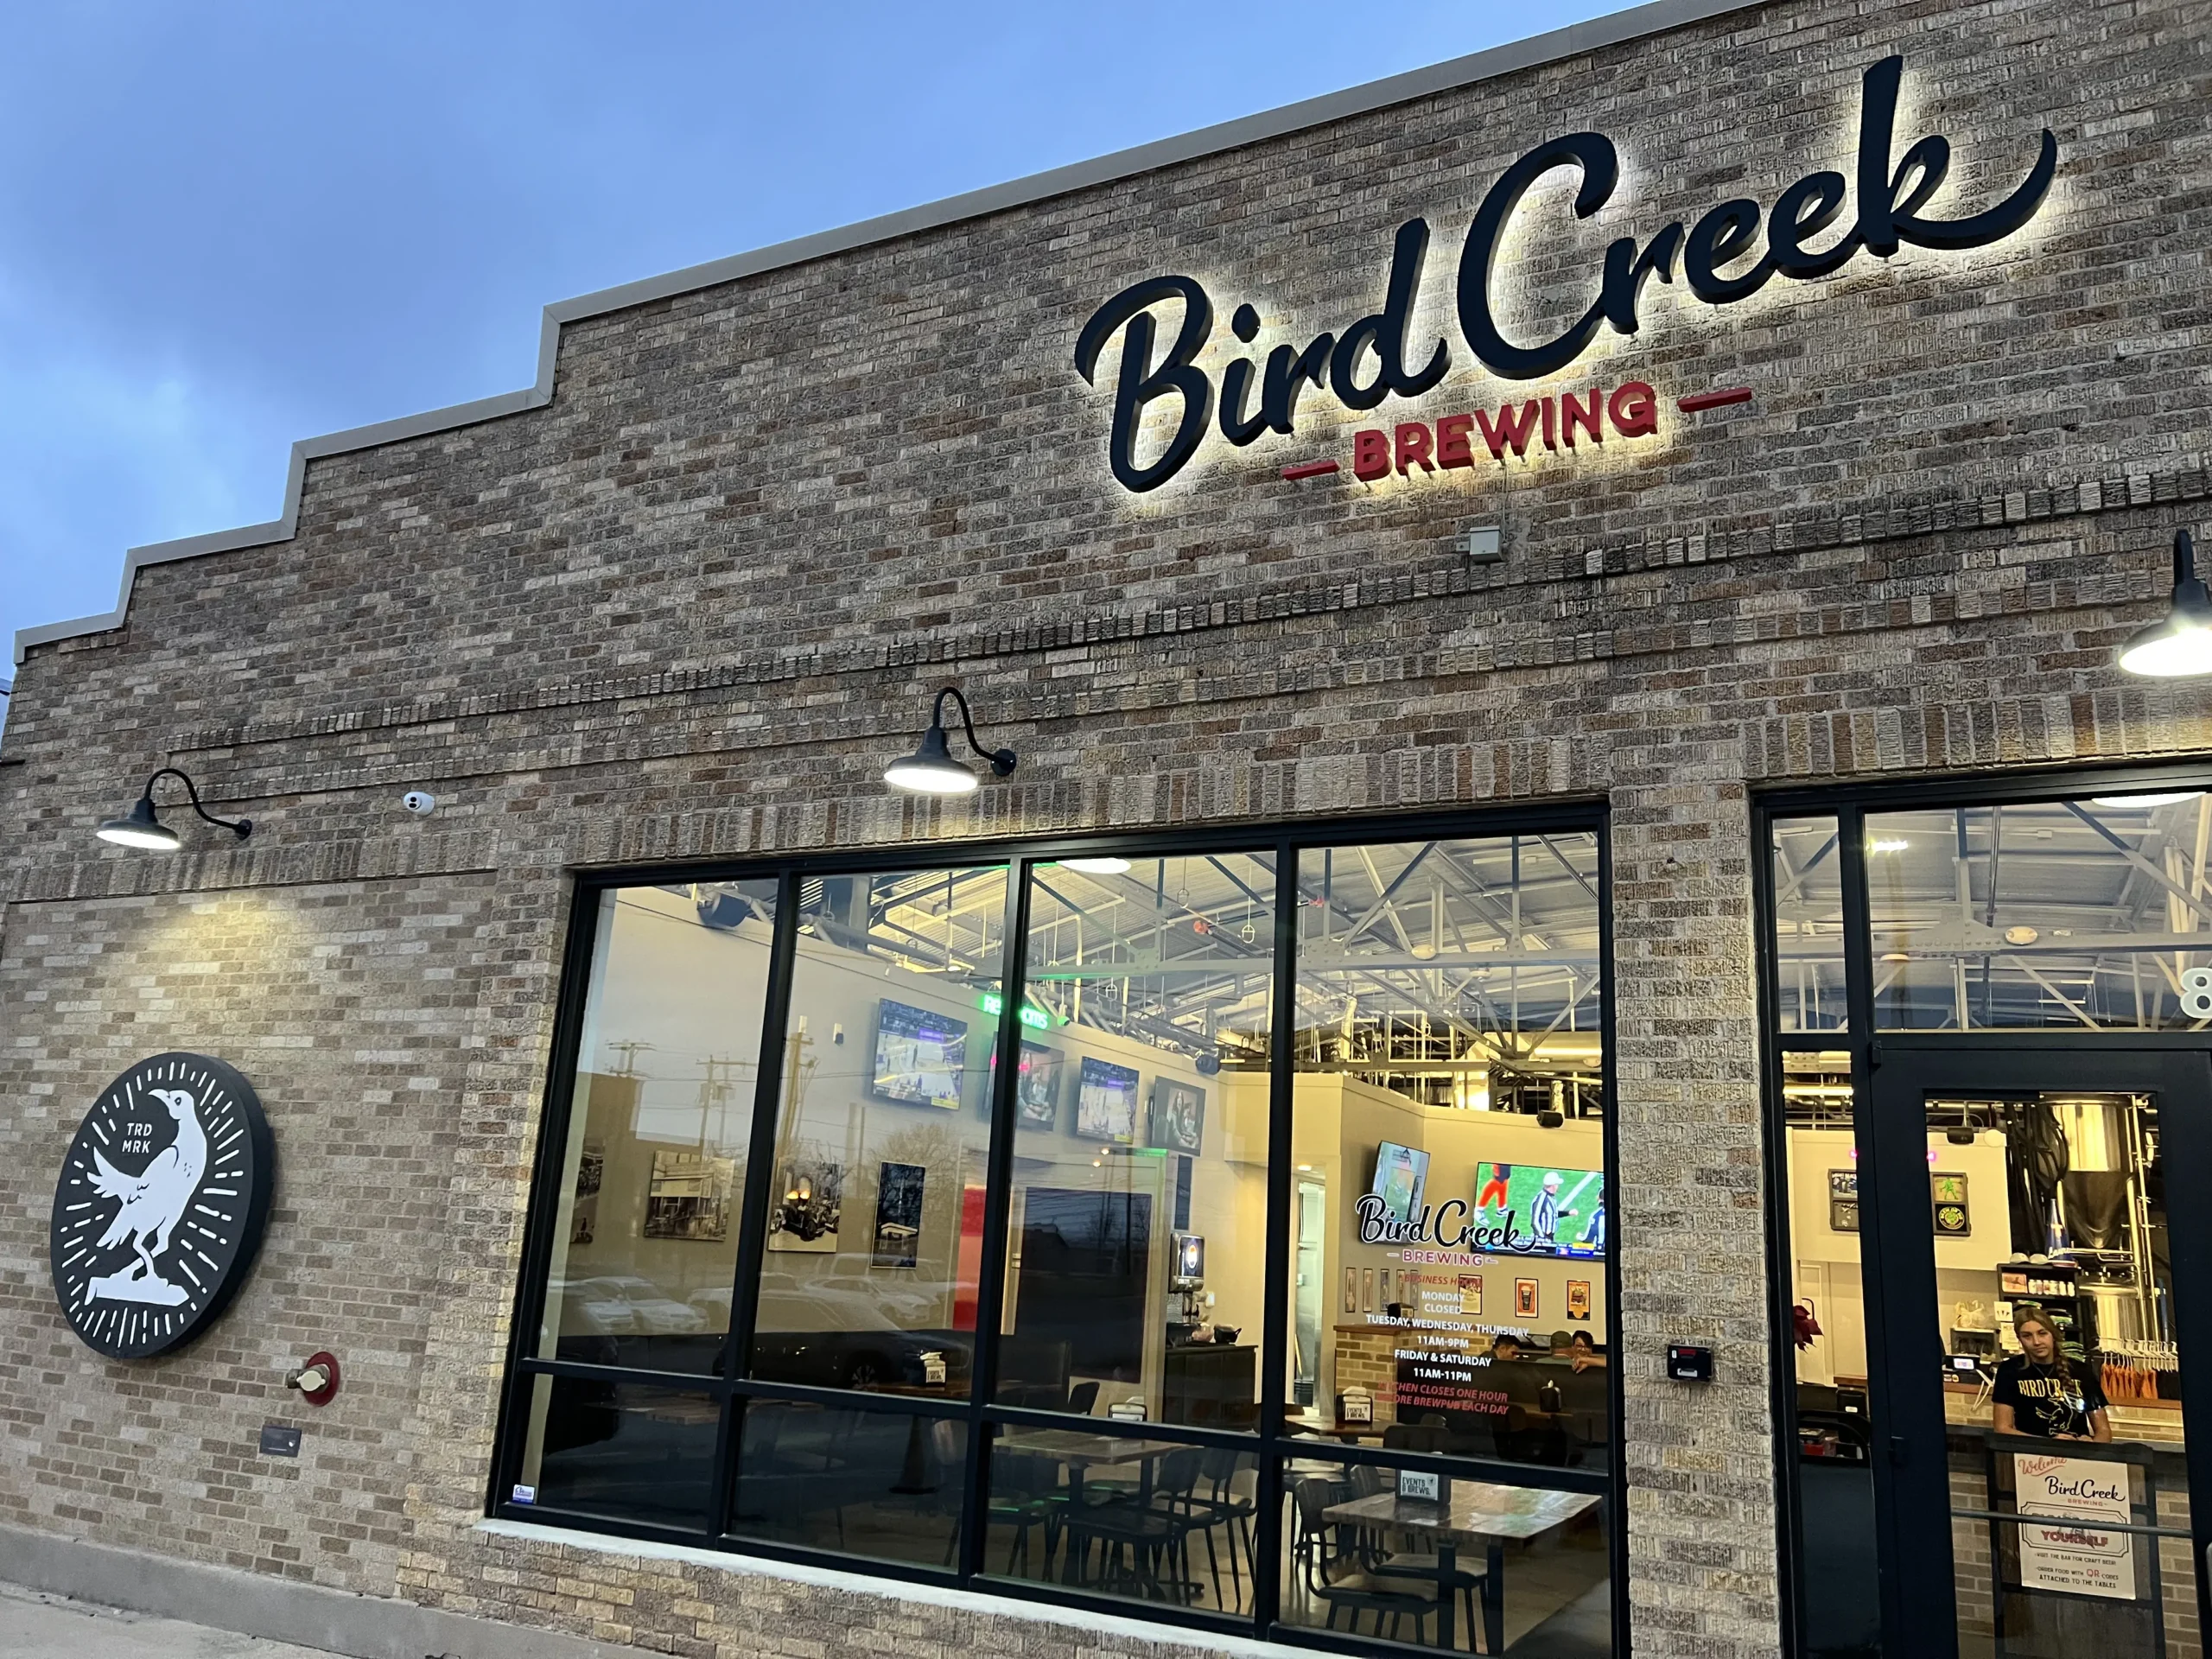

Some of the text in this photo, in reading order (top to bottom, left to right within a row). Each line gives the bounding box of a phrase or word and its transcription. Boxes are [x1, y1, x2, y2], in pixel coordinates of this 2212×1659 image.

[1076, 54, 2057, 493] Bird Creek
[1353, 381, 1658, 482] BREWING
[127, 1122, 153, 1137] TRD
[122, 1140, 151, 1154] MRK
[1356, 1194, 1536, 1252] Bird Creek
[1402, 1249, 1484, 1268] BREWING
[1404, 1274, 1448, 1285] BUSINESS
[1421, 1290, 1465, 1303] MONDAY
[1424, 1303, 1462, 1315] CLOSED
[1366, 1314, 1529, 1337] TUESDAY, WEDNESDAY, THURSDAY
[1417, 1336, 1469, 1349] 11AM-9PM
[1395, 1349, 1492, 1367] FRIDAY & SATURDAY
[1414, 1367, 1471, 1382] 11AM-11PM
[1420, 1384, 1455, 1397] CLOSES
[1457, 1388, 1478, 1399] ONE
[1478, 1389, 1508, 1402] HOUR
[2018, 1378, 2084, 1397] BIRD CRK
[1377, 1392, 1510, 1415] ORE BREWPUB EACH DAY
[2018, 1456, 2068, 1475] Welcome
[1402, 1477, 1426, 1487] EVENTS
[2044, 1475, 2126, 1501] Bird Creek
[2067, 1498, 2103, 1507] BREWING
[2041, 1530, 2108, 1548] YOURSELF
[2039, 1574, 2069, 1583] ATTACHED
[2086, 1568, 2100, 1578] QR
